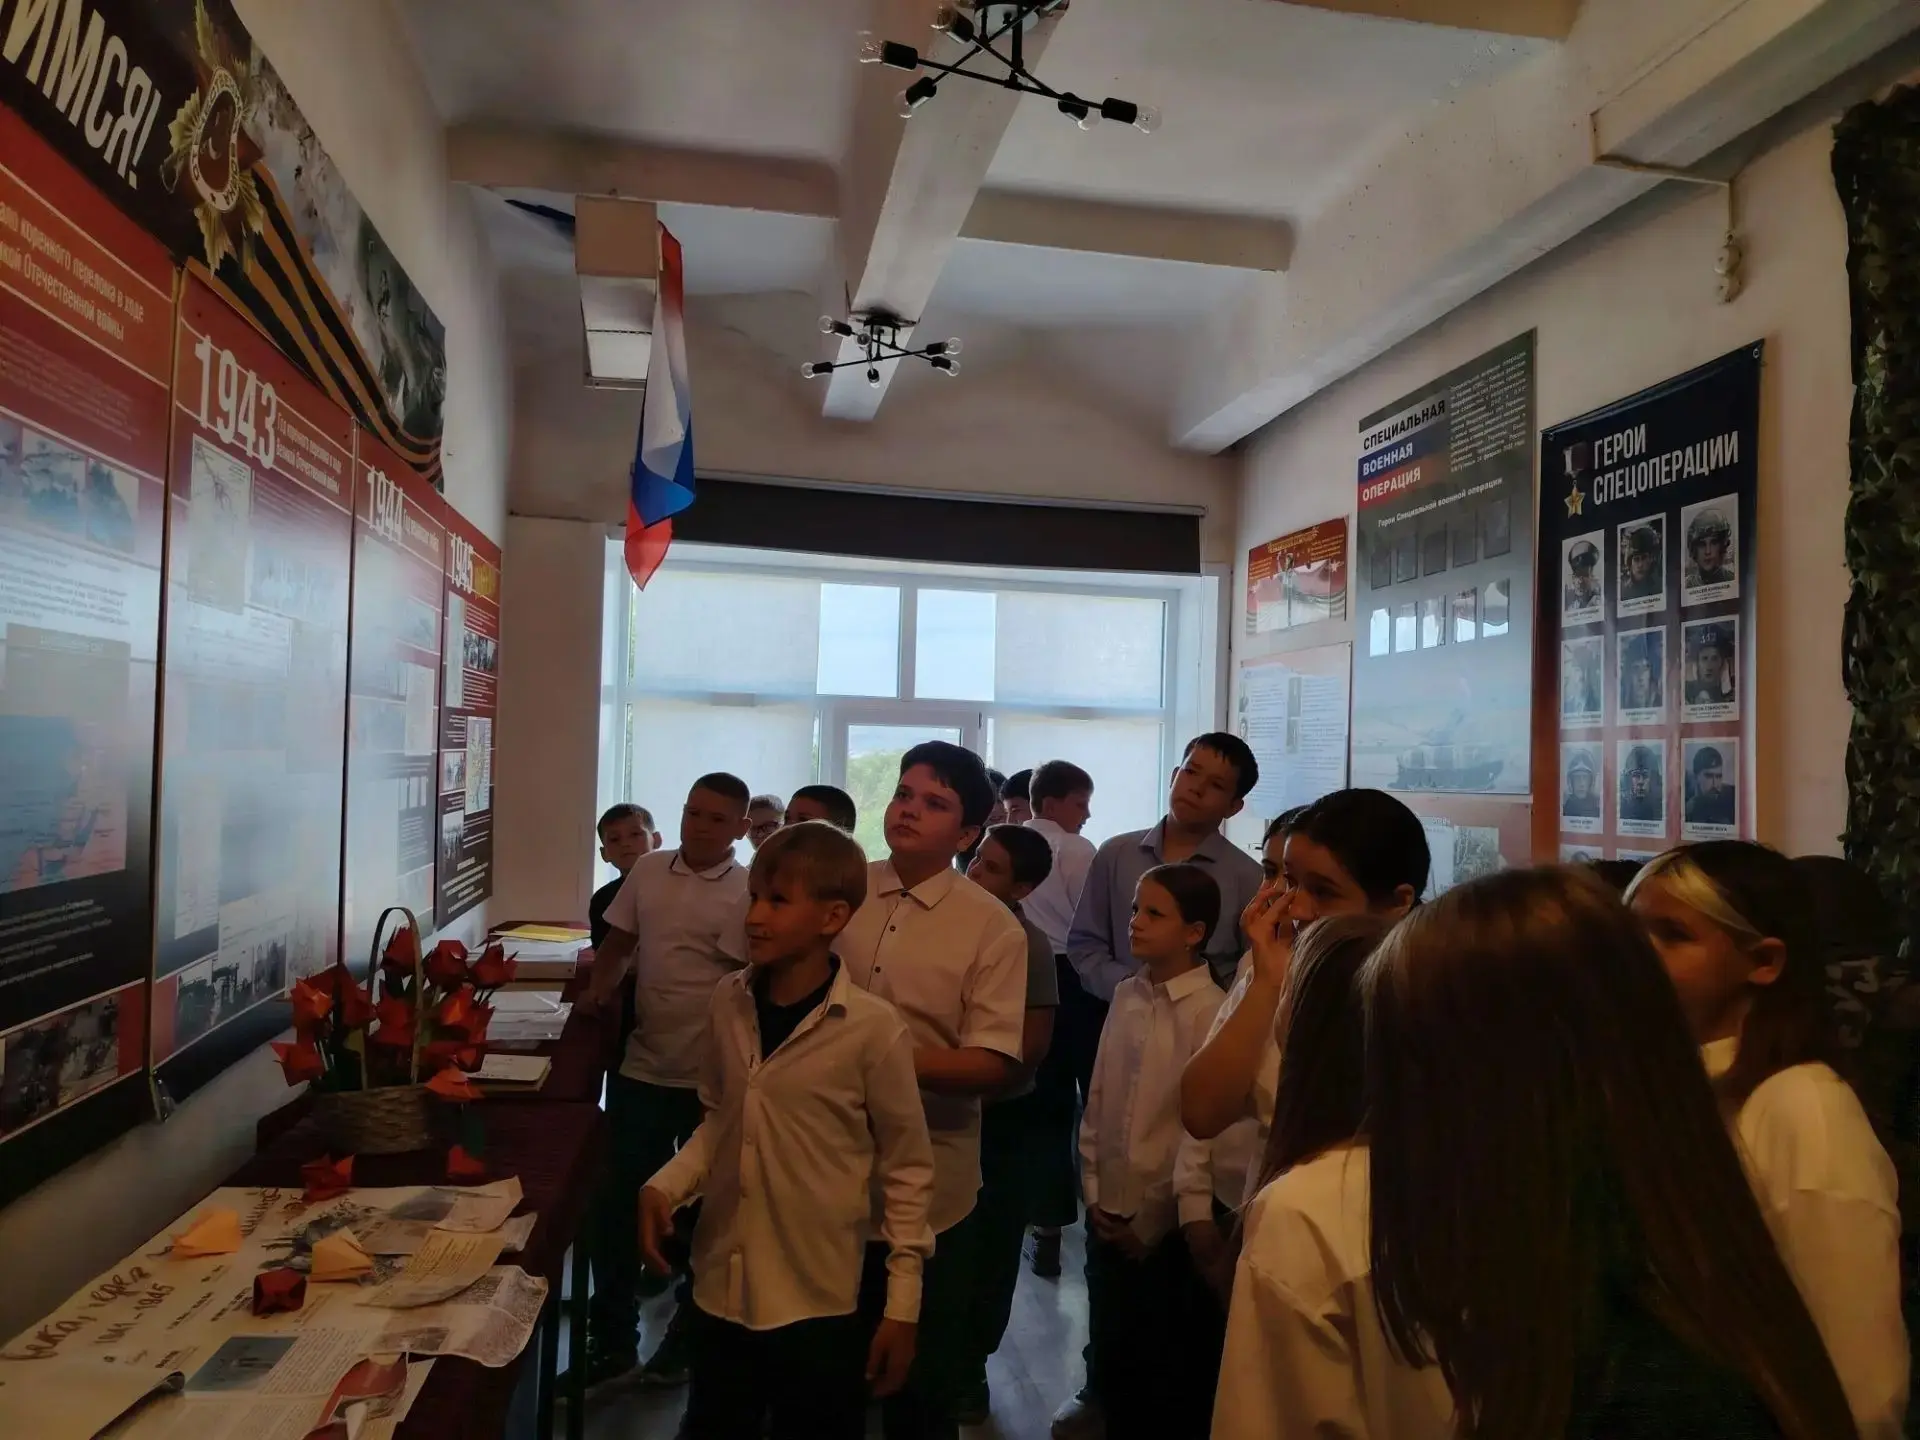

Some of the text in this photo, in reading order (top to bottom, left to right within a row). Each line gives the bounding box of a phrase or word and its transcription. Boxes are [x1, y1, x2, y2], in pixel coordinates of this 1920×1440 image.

[24, 253, 95, 322] Отечественной
[96, 308, 124, 342] войны
[72, 258, 116, 303] перелома
[194, 334, 277, 470] 1943
[1363, 399, 1446, 450] СПЕЦИАЛЬНАЯ
[1362, 442, 1413, 476] ВОЕННАЯ
[1593, 423, 1647, 470] ГЕРОИ
[1593, 430, 1739, 505] СПЕЦОПЕРАЦИИ
[367, 464, 404, 542] 1944
[1363, 466, 1421, 502] ОПЕРАЦИЯ
[1377, 477, 1503, 528] Герои Специальной военной операции
[450, 532, 473, 594] 1945
